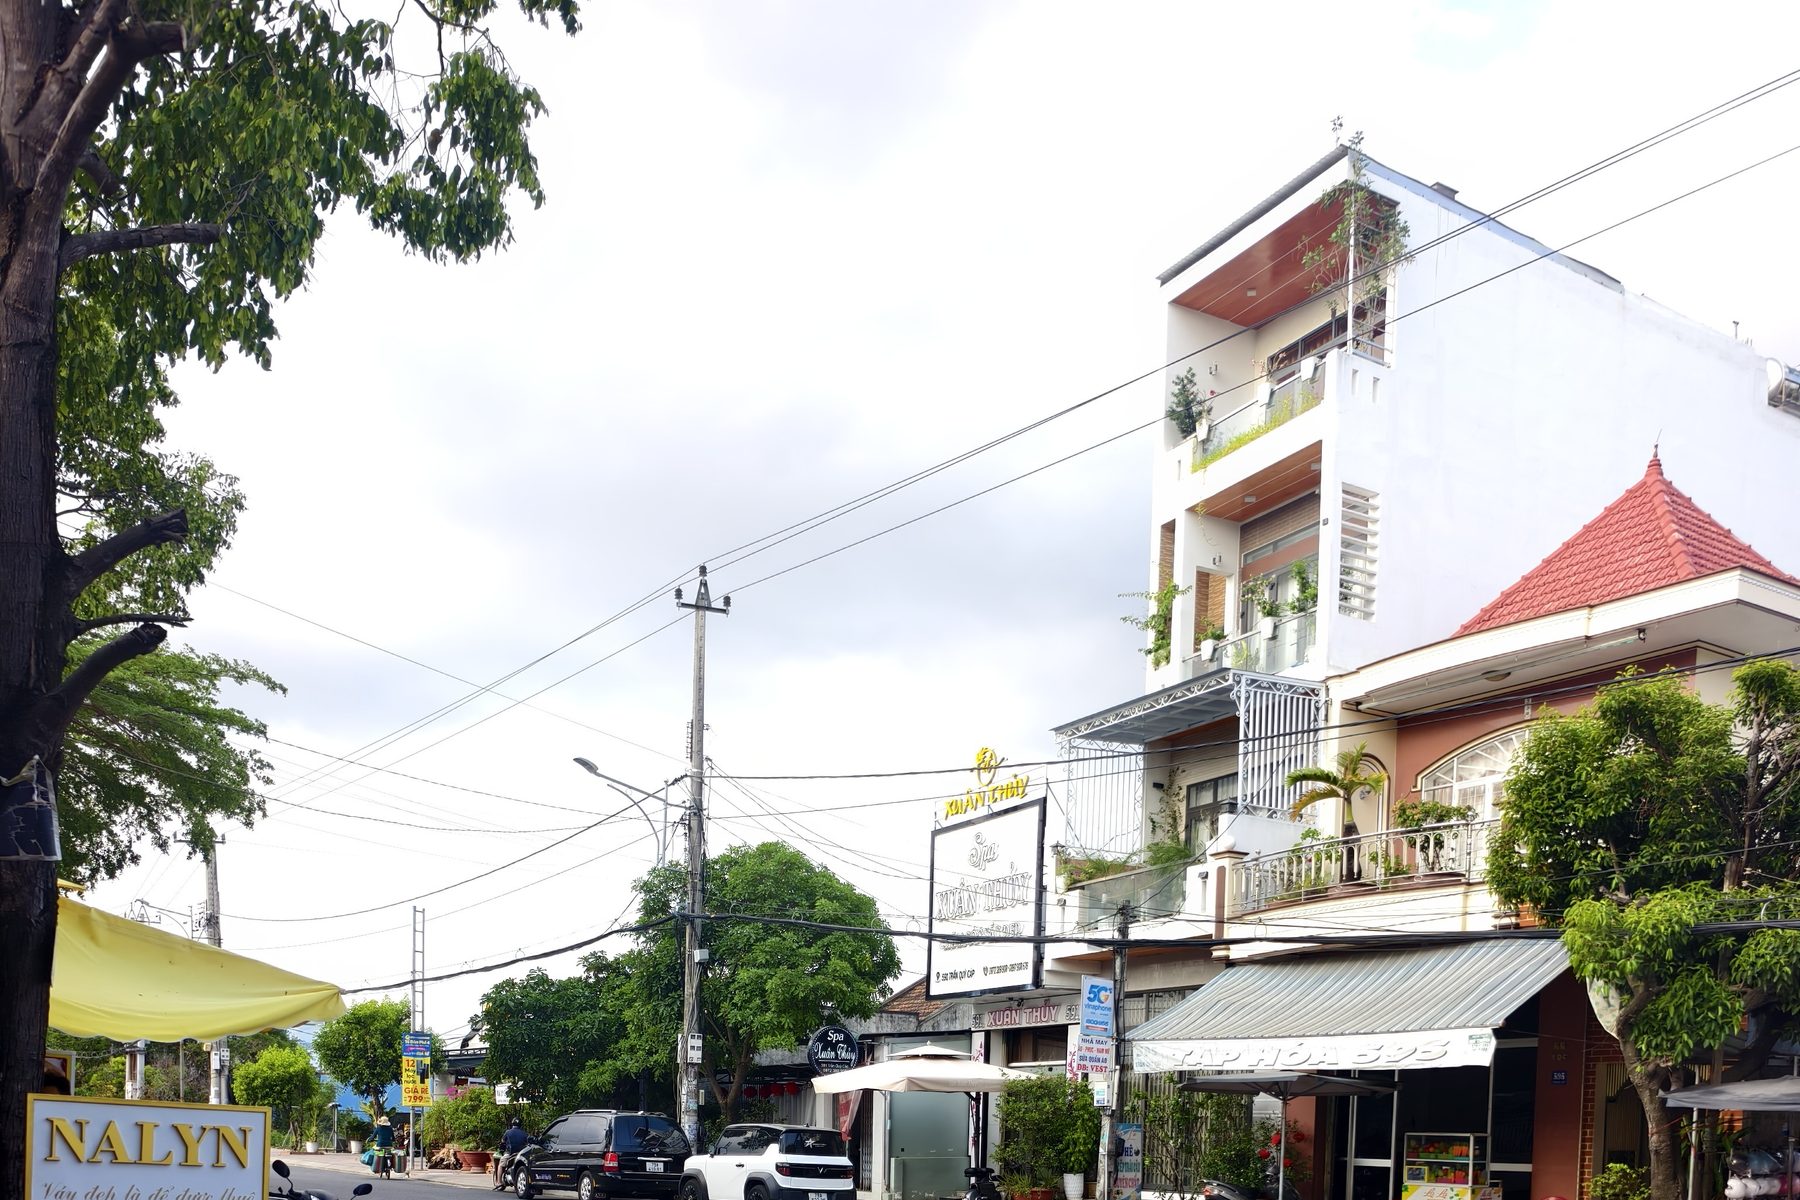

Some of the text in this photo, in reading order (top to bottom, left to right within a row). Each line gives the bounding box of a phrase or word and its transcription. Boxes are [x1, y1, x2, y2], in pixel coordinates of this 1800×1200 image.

[968, 831, 999, 871] Spa
[935, 877, 979, 922] XUÂN
[987, 1006, 1020, 1027] XUÂN
[827, 1030, 844, 1043] Spa
[1081, 1037, 1094, 1045] NHÀ
[813, 1042, 836, 1059] Xuân
[405, 1059, 416, 1068] 12
[1090, 1064, 1108, 1073] VEST
[404, 1084, 419, 1094] GIÁ
[45, 1117, 253, 1168] NALYN
